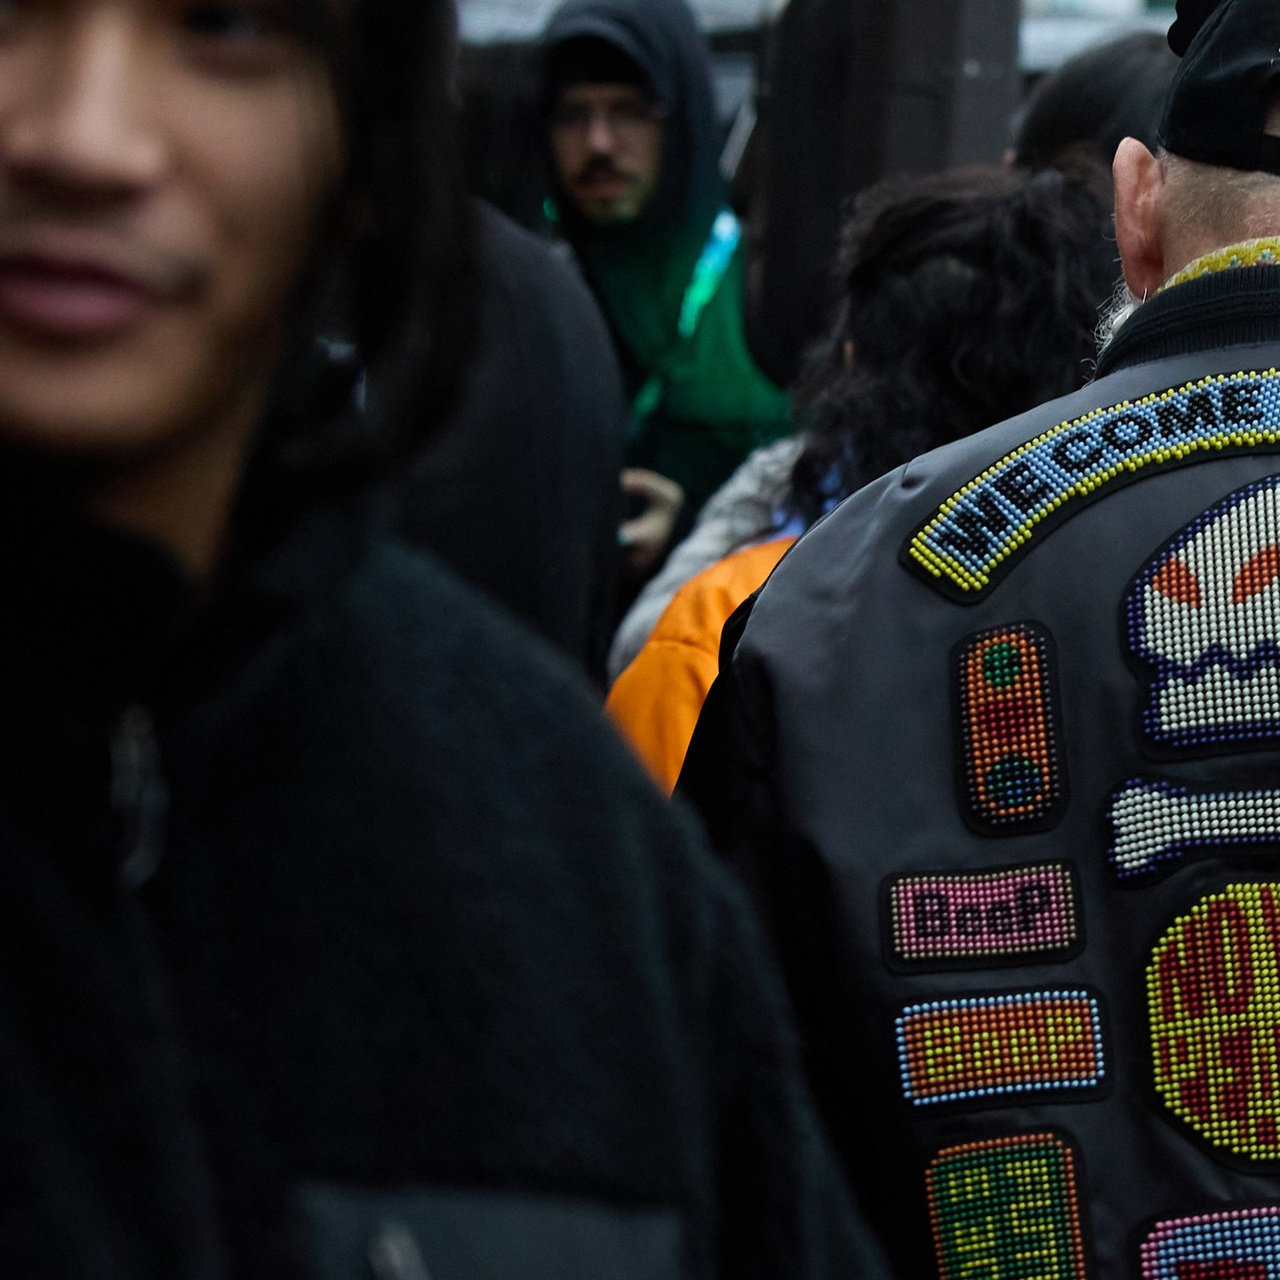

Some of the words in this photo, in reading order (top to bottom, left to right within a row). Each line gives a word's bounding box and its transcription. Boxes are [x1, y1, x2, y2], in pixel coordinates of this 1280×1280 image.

[938, 460, 1051, 559] WE
[1051, 383, 1264, 471] COME
[1158, 898, 1255, 1022] NO
